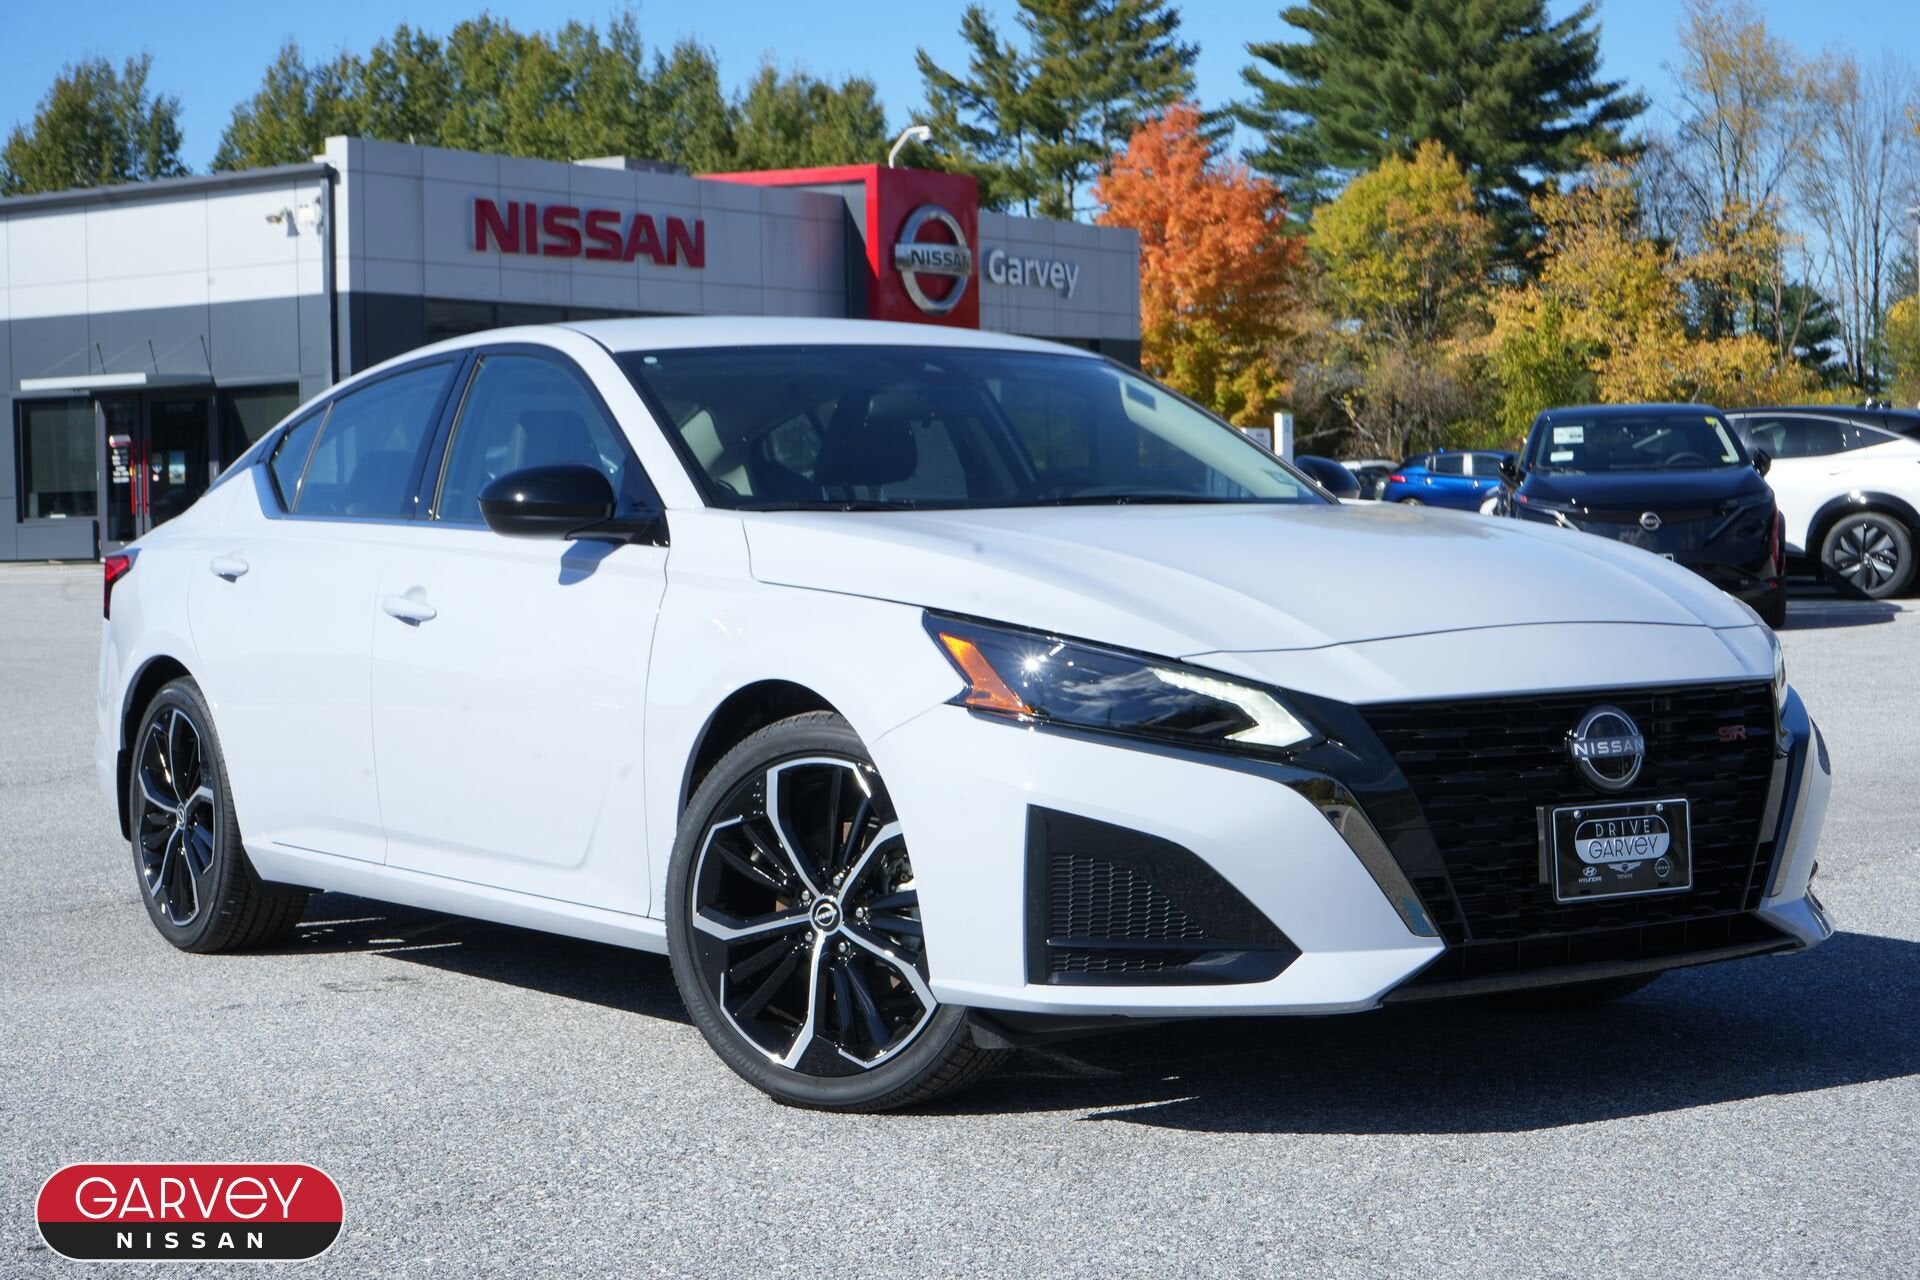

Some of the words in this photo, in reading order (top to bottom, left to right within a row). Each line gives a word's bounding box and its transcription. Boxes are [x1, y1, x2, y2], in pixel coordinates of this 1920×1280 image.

[474, 198, 705, 269] NISSAN
[910, 249, 970, 269] NISSAN
[988, 249, 1079, 299] Garvey
[1718, 724, 1747, 742] SR
[1574, 738, 1644, 756] NISSAN
[1596, 819, 1650, 837] DRIVE
